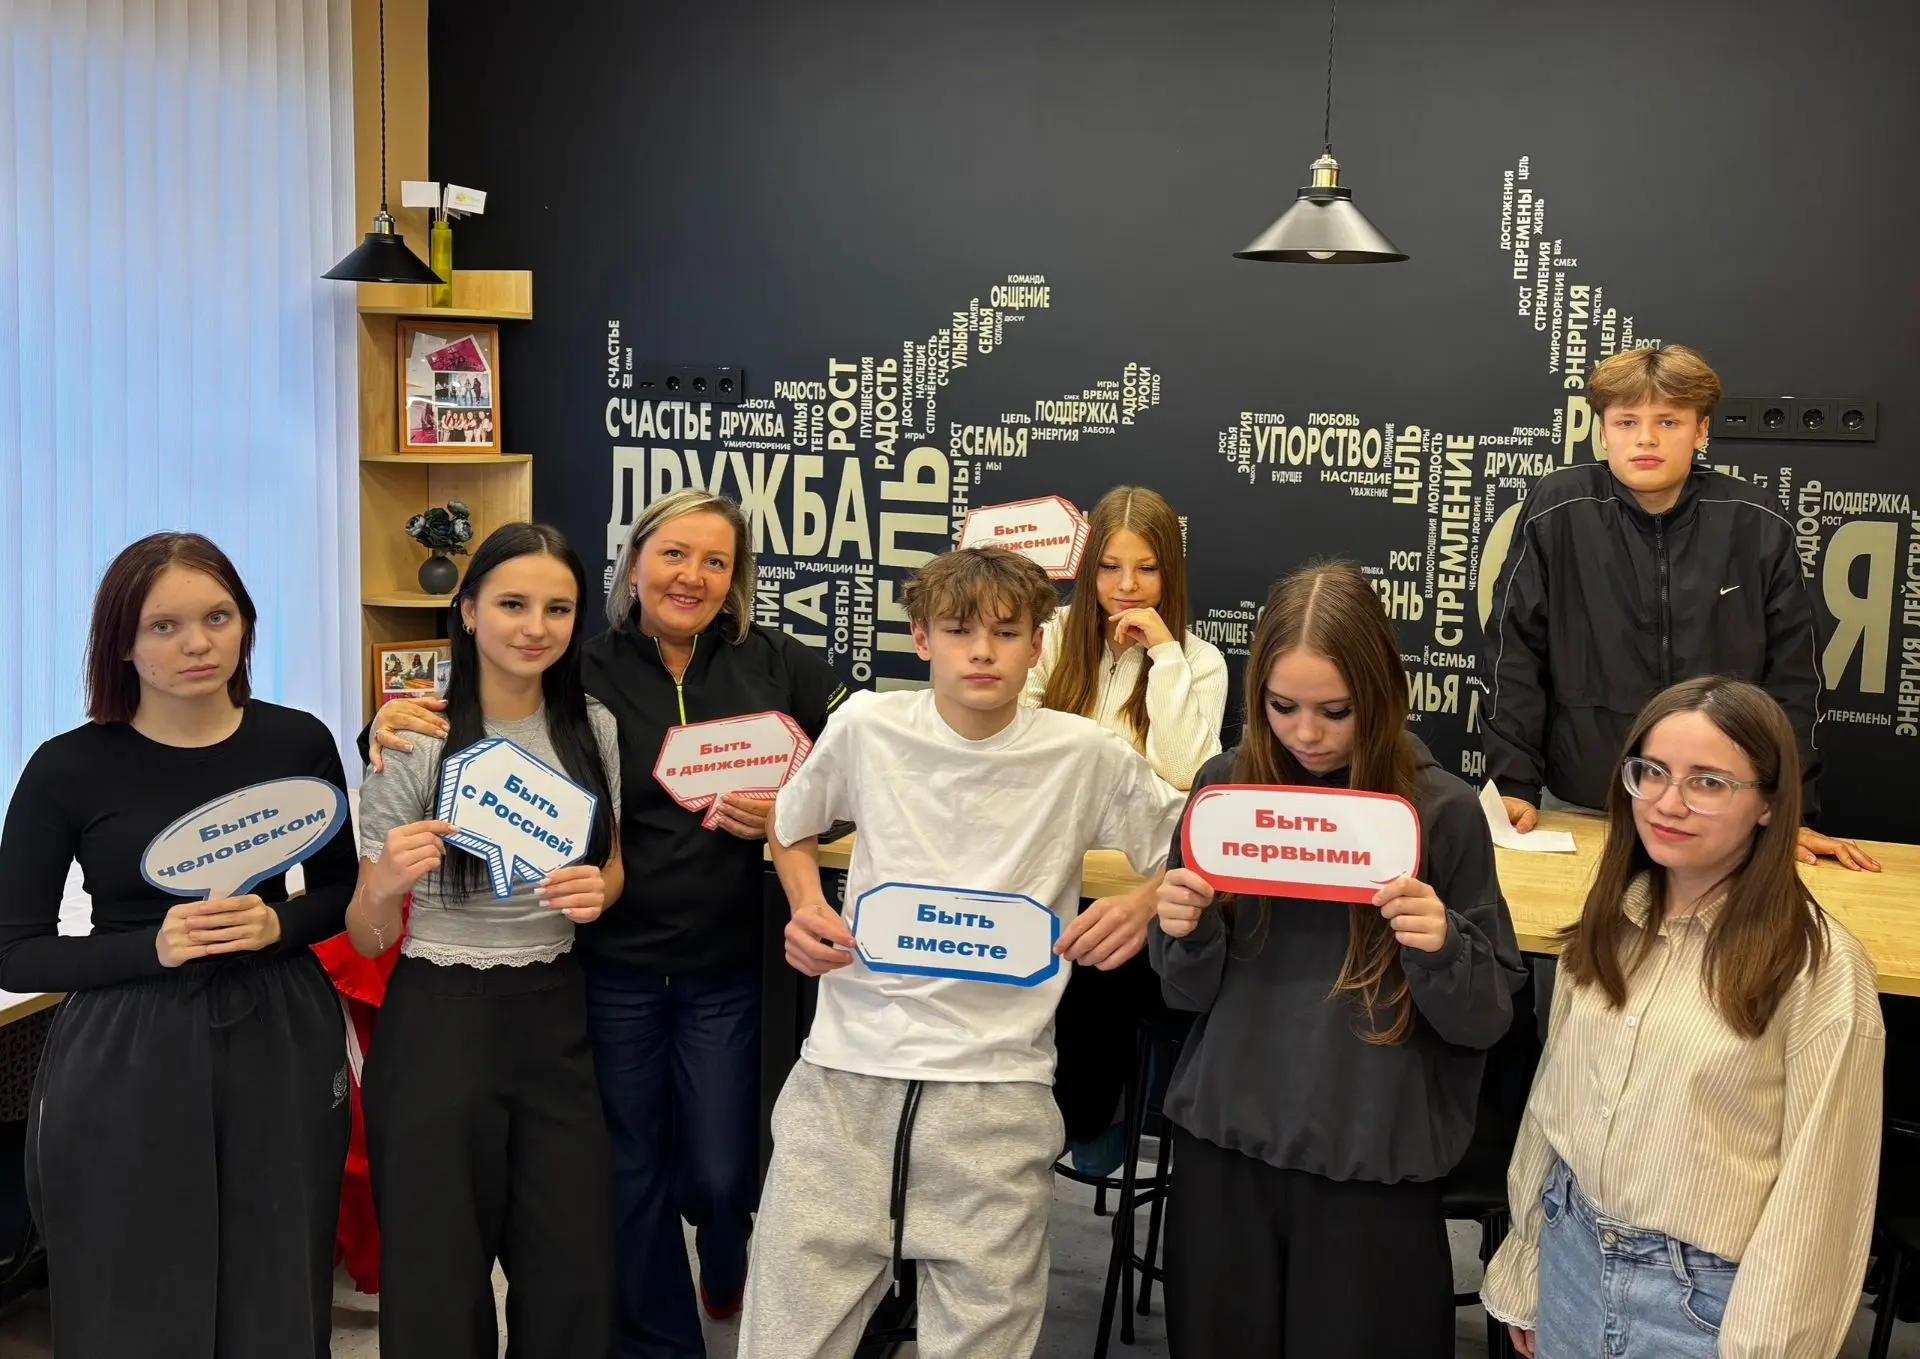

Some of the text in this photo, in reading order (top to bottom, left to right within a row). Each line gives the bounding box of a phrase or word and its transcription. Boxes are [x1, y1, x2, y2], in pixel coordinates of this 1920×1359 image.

[1518, 155, 1530, 180] ЦЕЛЬ
[1500, 170, 1514, 251] ДОСТИЖЕНИЯ
[1533, 198, 1545, 235] ЖИЗНЬ
[1513, 188, 1533, 280] ПЕРЕМЕНЫ
[1553, 239, 1562, 255] ВЕРА
[1553, 258, 1578, 267] СМЕХ
[1007, 274, 1045, 285] КОМАНДА
[1534, 241, 1551, 331] СТРЕМЛЕНИЯ
[990, 285, 1050, 310] ОБЩЕНИЕ
[1518, 286, 1532, 316] РОСТ
[1593, 286, 1603, 326] ЧУВСТВА
[969, 297, 979, 331] ПАМЯТЬ
[1549, 271, 1565, 374] УМИРОТВОРЕНИЕ
[952, 311, 968, 369] УЛЫБКИ
[978, 307, 994, 354] СЕМЬЯ
[1563, 285, 1591, 389] ЭНЕРГИЯ
[1600, 307, 1617, 356] ЦЕЛЬ
[1635, 338, 1661, 350] РОСТ
[608, 320, 620, 388] СЧАСТЬЕ
[938, 328, 950, 386] СЧАСТЬЕ
[902, 340, 914, 427] ДОСТИЖЕНИЯ
[916, 344, 926, 398] НАСЛЕДИЕ
[926, 335, 938, 434] СПЛОЧЁННОСТЬ
[737, 399, 776, 410] АБОТА
[774, 380, 826, 402] РАДОСТЬ
[828, 358, 857, 450] РОСТ
[860, 357, 874, 438] ПУТЕШЕСТВИЯ
[1083, 389, 1119, 400] ВРЕМЯ
[1122, 361, 1137, 425] РАДОСТЬ
[1138, 366, 1151, 411] УРОКИ
[1151, 374, 1161, 406] ТЕПЛО
[605, 397, 712, 441] СЧАСТЬЕ
[719, 411, 785, 438] ДРУЖБА
[793, 402, 808, 446] СЕМЬЯ
[811, 404, 824, 453] ТЕПЛО
[875, 358, 900, 469] РАДОСТЬ
[1001, 413, 1031, 424] ЦЕЛЬ
[1035, 400, 1118, 425] ПОДДЕРЖКА
[1254, 413, 1285, 425] ТЕПЛО
[1307, 413, 1360, 426] ЛЮБОВЬ
[1551, 408, 1564, 445] СЕМЬЯ
[723, 440, 791, 451] УМИРОТВОРЕНИЕ
[950, 422, 963, 457] РОСТ
[962, 425, 1028, 457] СЕМЬЯ
[1031, 427, 1079, 442] ЭНЕРГИЯ
[1082, 426, 1115, 435] ЗАБОТА
[1218, 431, 1227, 454] РОСТ
[1227, 426, 1238, 462] СЕМЬЯ
[1238, 411, 1253, 474] ЭНЕРГИЯ
[1383, 422, 1395, 468] ПОНИМАНИЕ
[1422, 429, 1430, 453] ИГРЫ
[1478, 435, 1534, 446] ДОВЕРИЕ
[1512, 427, 1551, 437] ЛЮБОВЬ
[1253, 425, 1382, 469] УПОРСТВО
[985, 461, 1002, 471] МЫ
[1271, 470, 1303, 484] БУДУЩЕЕ
[1320, 470, 1392, 485] НАСЛЕДИЕ
[1392, 425, 1423, 504] ЦЕЛЬ
[1428, 432, 1443, 514] МОЛОДОСТЬ
[1484, 452, 1554, 478] ДРУЖБА
[1350, 487, 1388, 498] УВАЖЕНИЕ
[1498, 477, 1527, 489] ЖИЗНЬ
[1472, 496, 1482, 534] ДОВЕРИЕ
[1484, 483, 1497, 523] ЭНЕРГИЯ
[1823, 490, 1910, 515] ПОДДЕРЖКА
[994, 523, 1038, 536] Быть
[1821, 515, 1843, 526] РОСТ
[1434, 435, 1475, 646] СТРЕМЛЕНИЕ
[757, 565, 796, 580] ЖИЗНЬ
[794, 561, 853, 574] ТРАДИЦИИ
[1389, 550, 1422, 572] РОСТ
[1425, 518, 1438, 599] ВЗАИМООТНОШЕНИЯ
[1469, 545, 1479, 591] ЧЕСТНОСТЬ
[1208, 609, 1255, 620] ЛЮБОВЬ
[1370, 578, 1424, 621] ЗНЬ
[833, 580, 850, 654] СОВЕТЫ
[852, 563, 875, 682] ОБЩЕНИЕ
[1195, 620, 1248, 646] БУДУЩЕЕ
[1430, 651, 1476, 669] СЕМЬЯ
[1895, 637, 1920, 737] ЭНЕРГИЯ
[1827, 709, 1892, 726] ПЕРЕМЕНЫ
[700, 740, 752, 756] Быть
[665, 753, 789, 777] в движении
[503, 773, 560, 819] Быть
[198, 804, 280, 844] Быть
[460, 784, 576, 859] с Россией
[1254, 808, 1339, 835] Быть
[156, 808, 327, 880] человеком
[1221, 838, 1372, 866] первыми
[916, 903, 995, 930] Быть
[897, 934, 1008, 961] вместе
